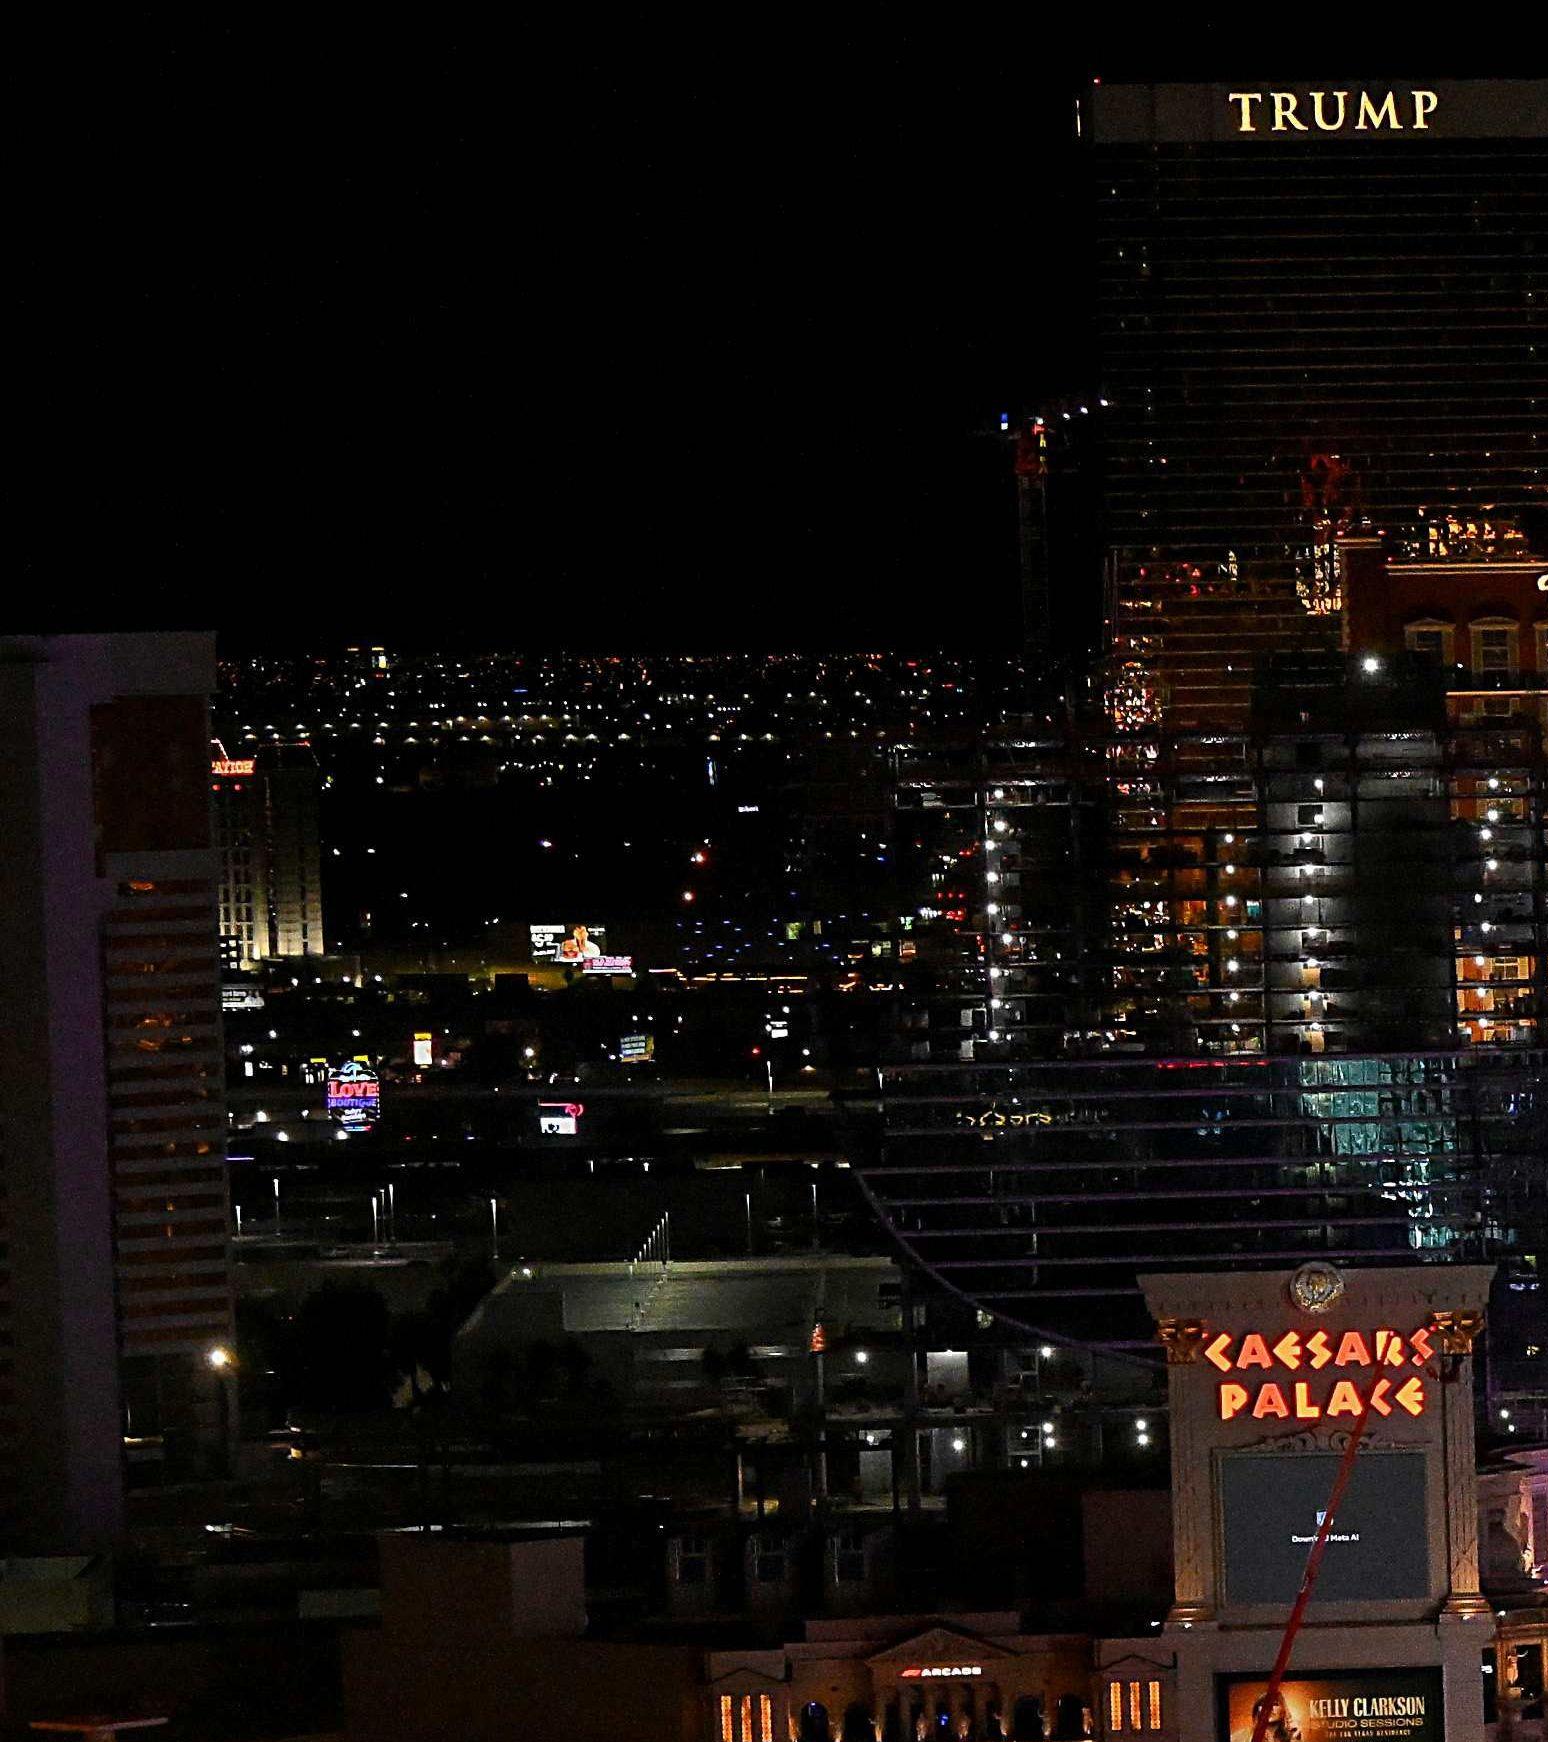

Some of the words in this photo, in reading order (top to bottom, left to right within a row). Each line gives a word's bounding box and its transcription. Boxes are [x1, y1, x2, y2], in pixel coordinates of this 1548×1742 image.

[1228, 91, 1439, 133] TRUMP
[330, 1081, 377, 1098] LOVE
[1204, 1328, 1435, 1372] CAESARS
[1220, 1377, 1425, 1421] PALACE
[921, 1666, 982, 1677] ARCADE
[1309, 1698, 1349, 1718] KELLY
[1353, 1696, 1425, 1716] CLARKSON
[1360, 1717, 1424, 1727] SESSIONS
